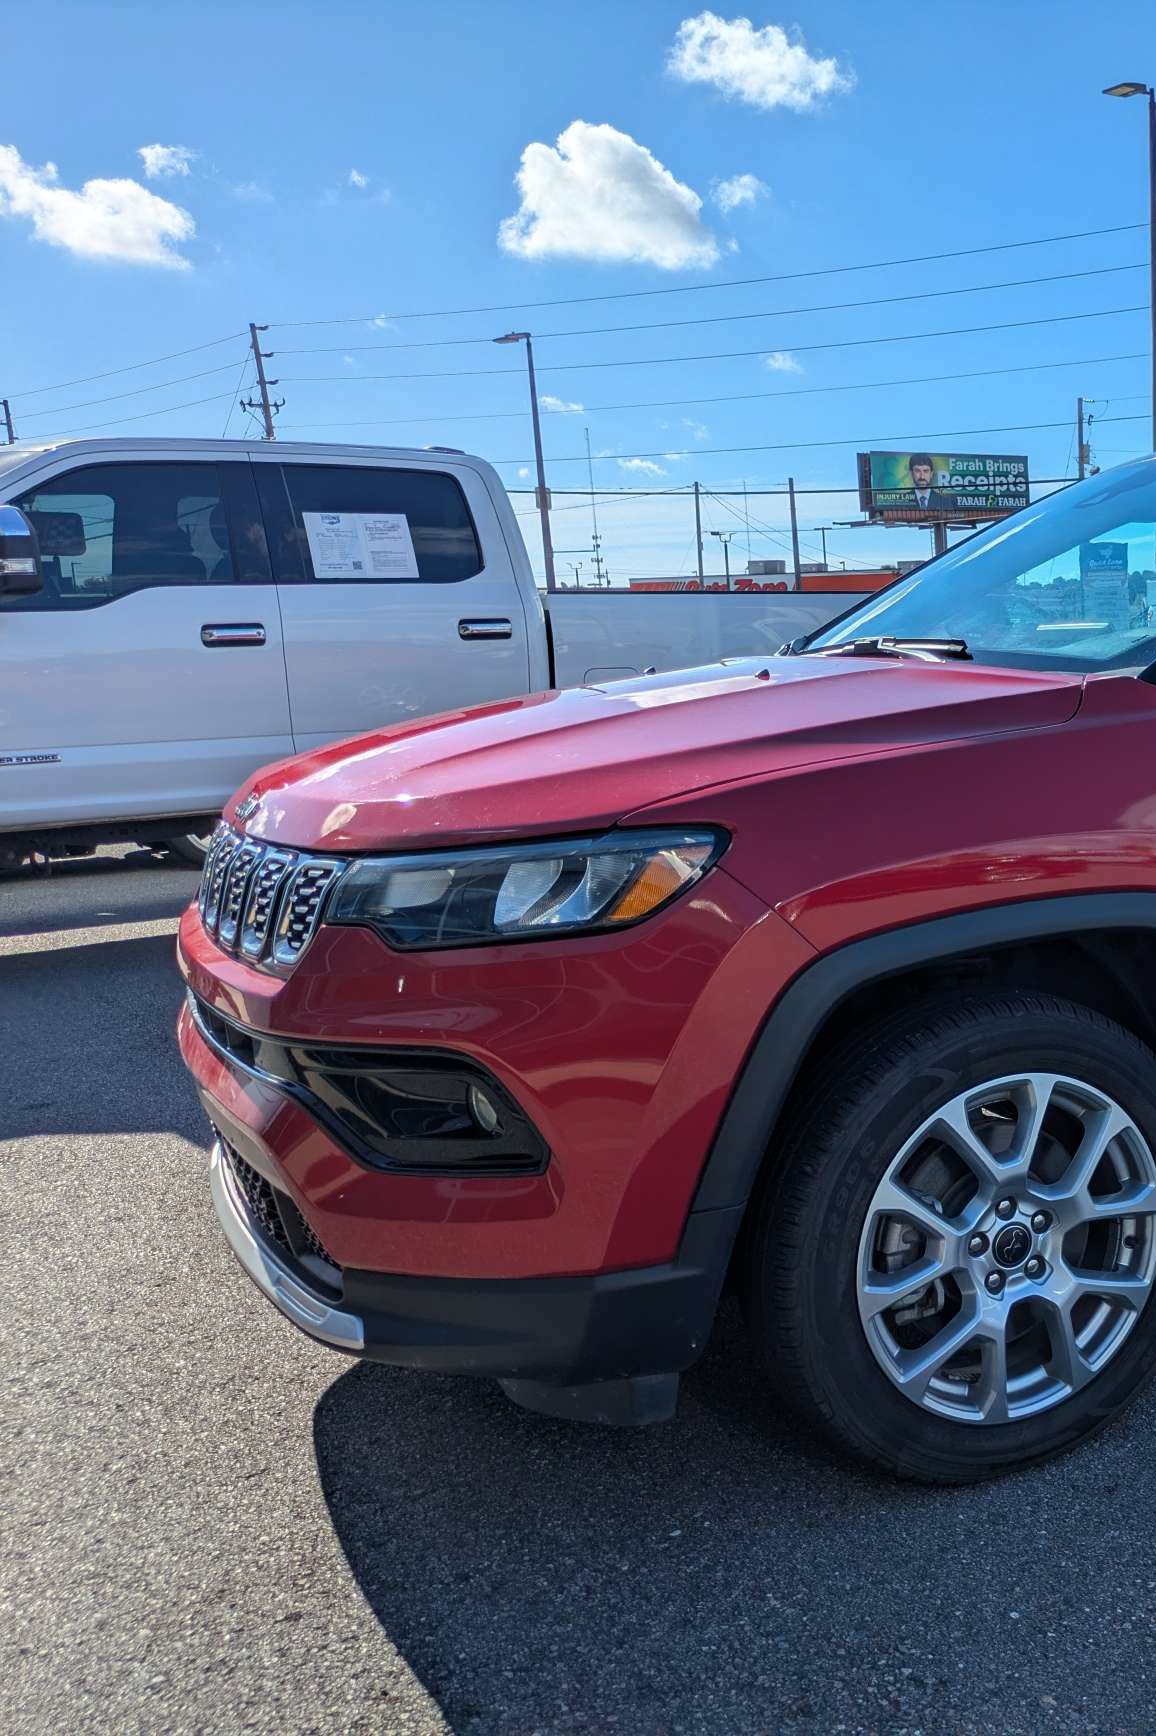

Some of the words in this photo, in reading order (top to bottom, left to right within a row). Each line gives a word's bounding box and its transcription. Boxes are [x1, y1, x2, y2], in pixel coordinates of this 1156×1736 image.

[949, 459, 983, 471] Farah
[986, 460, 1024, 475] Brings
[937, 471, 1026, 495] Receipts
[957, 496, 986, 506] FARAH
[998, 497, 1026, 507] FARAH
[16, 754, 59, 763] STROKE
